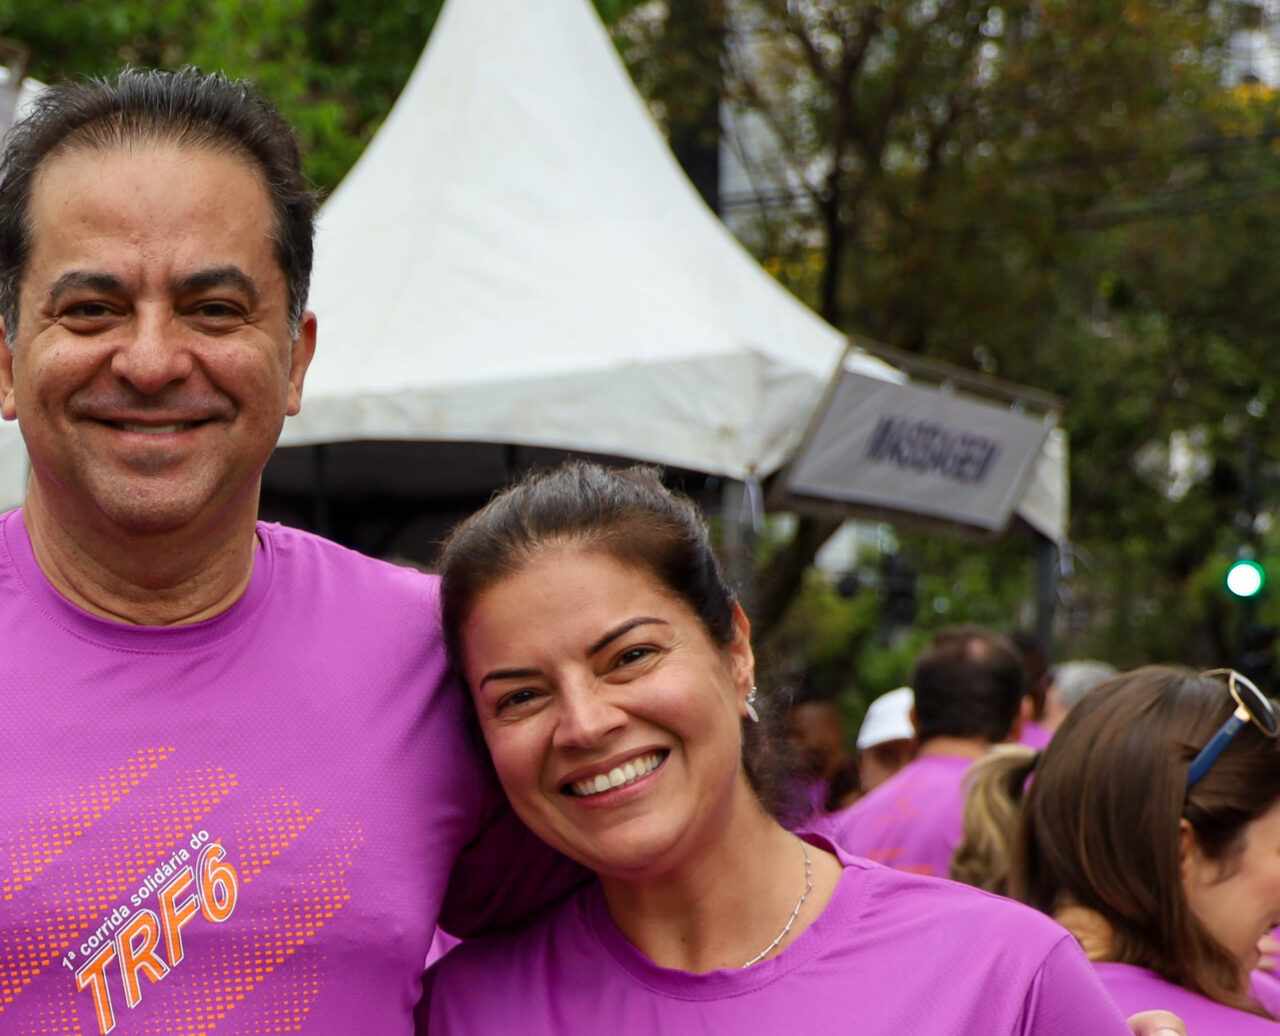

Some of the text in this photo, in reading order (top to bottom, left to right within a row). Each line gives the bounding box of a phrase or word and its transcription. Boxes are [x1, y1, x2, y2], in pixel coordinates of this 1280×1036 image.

[75, 838, 239, 1036] TRF6
[80, 904, 131, 957] corrida
[130, 847, 190, 907] solidária
[189, 830, 209, 849] do
